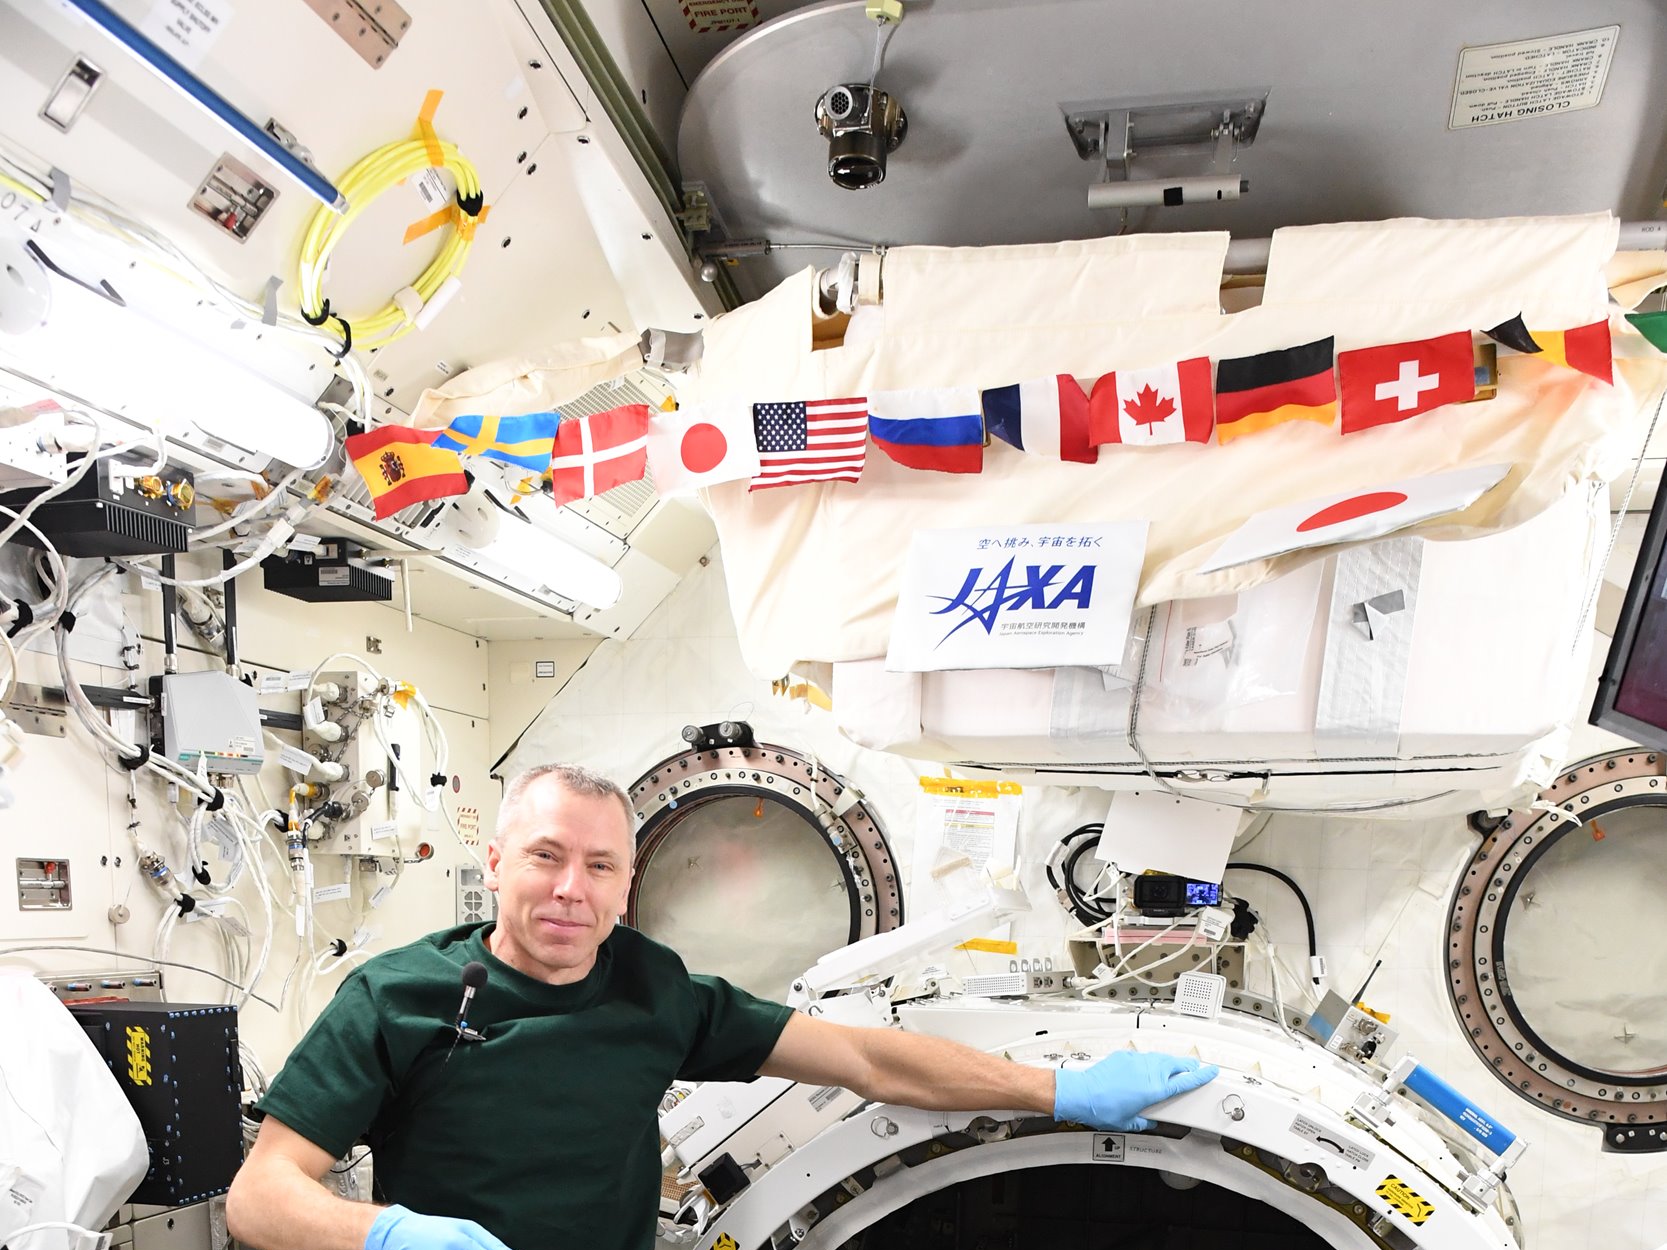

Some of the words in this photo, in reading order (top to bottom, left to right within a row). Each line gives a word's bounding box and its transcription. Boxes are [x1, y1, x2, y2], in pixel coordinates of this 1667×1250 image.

[720, 6, 748, 14] PORT
[1516, 100, 1570, 115] CLOSING
[1471, 110, 1512, 122] HATCH
[976, 536, 1103, 550] 空へ挑み、宇宙を拓く
[925, 555, 1098, 650] JAXA
[1001, 622, 1086, 630] 宇宙航空研究開発機構
[1390, 1184, 1410, 1200] CAUTION
